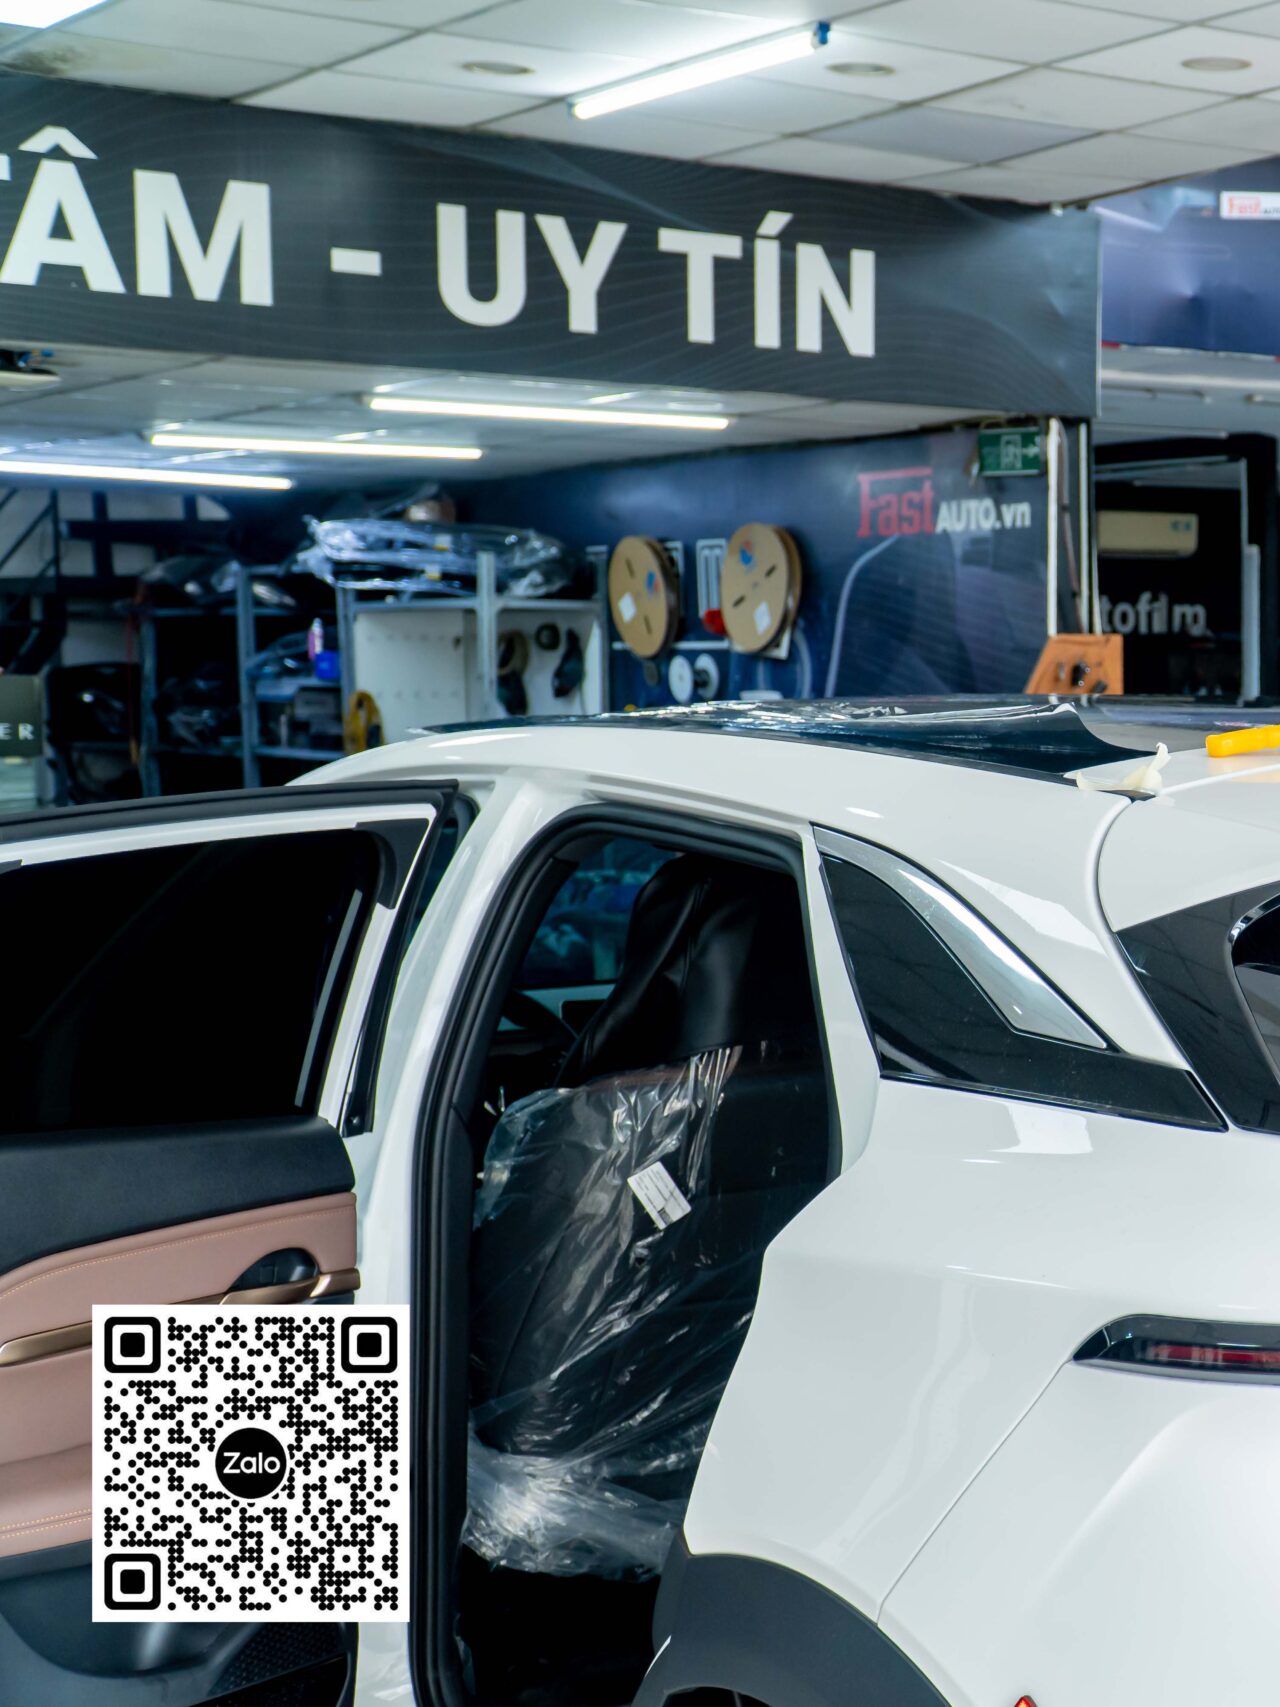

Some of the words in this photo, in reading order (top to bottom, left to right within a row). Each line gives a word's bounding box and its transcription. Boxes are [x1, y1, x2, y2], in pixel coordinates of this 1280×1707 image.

[0, 125, 274, 307] ÂM
[436, 203, 628, 335] UY
[657, 210, 877, 358] TÍN
